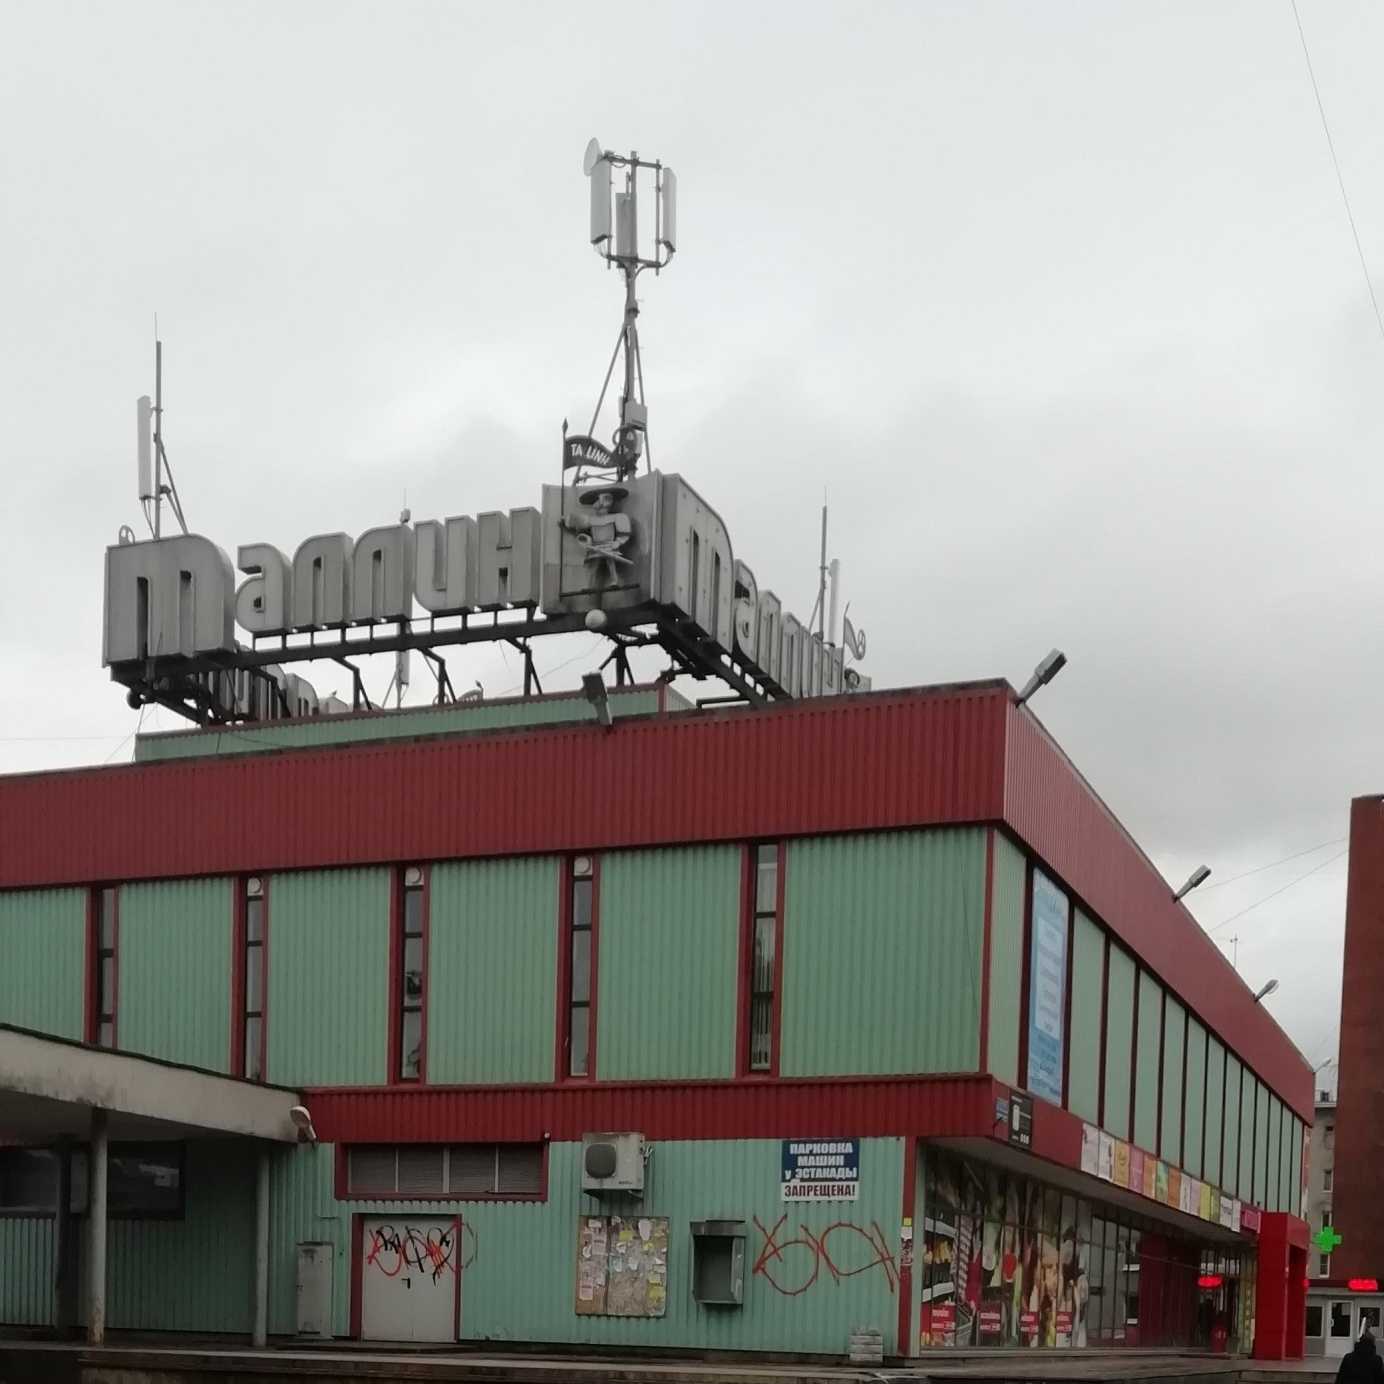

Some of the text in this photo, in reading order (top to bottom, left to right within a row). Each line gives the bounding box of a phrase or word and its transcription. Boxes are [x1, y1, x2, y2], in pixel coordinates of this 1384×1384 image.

[789, 1142, 853, 1154] ПАРКОВКА
[797, 1154, 845, 1167] МАШИН
[795, 1167, 858, 1180] ЭСТАКАДЫ
[784, 1184, 856, 1198] ЗАПРЕЩЕНА!
